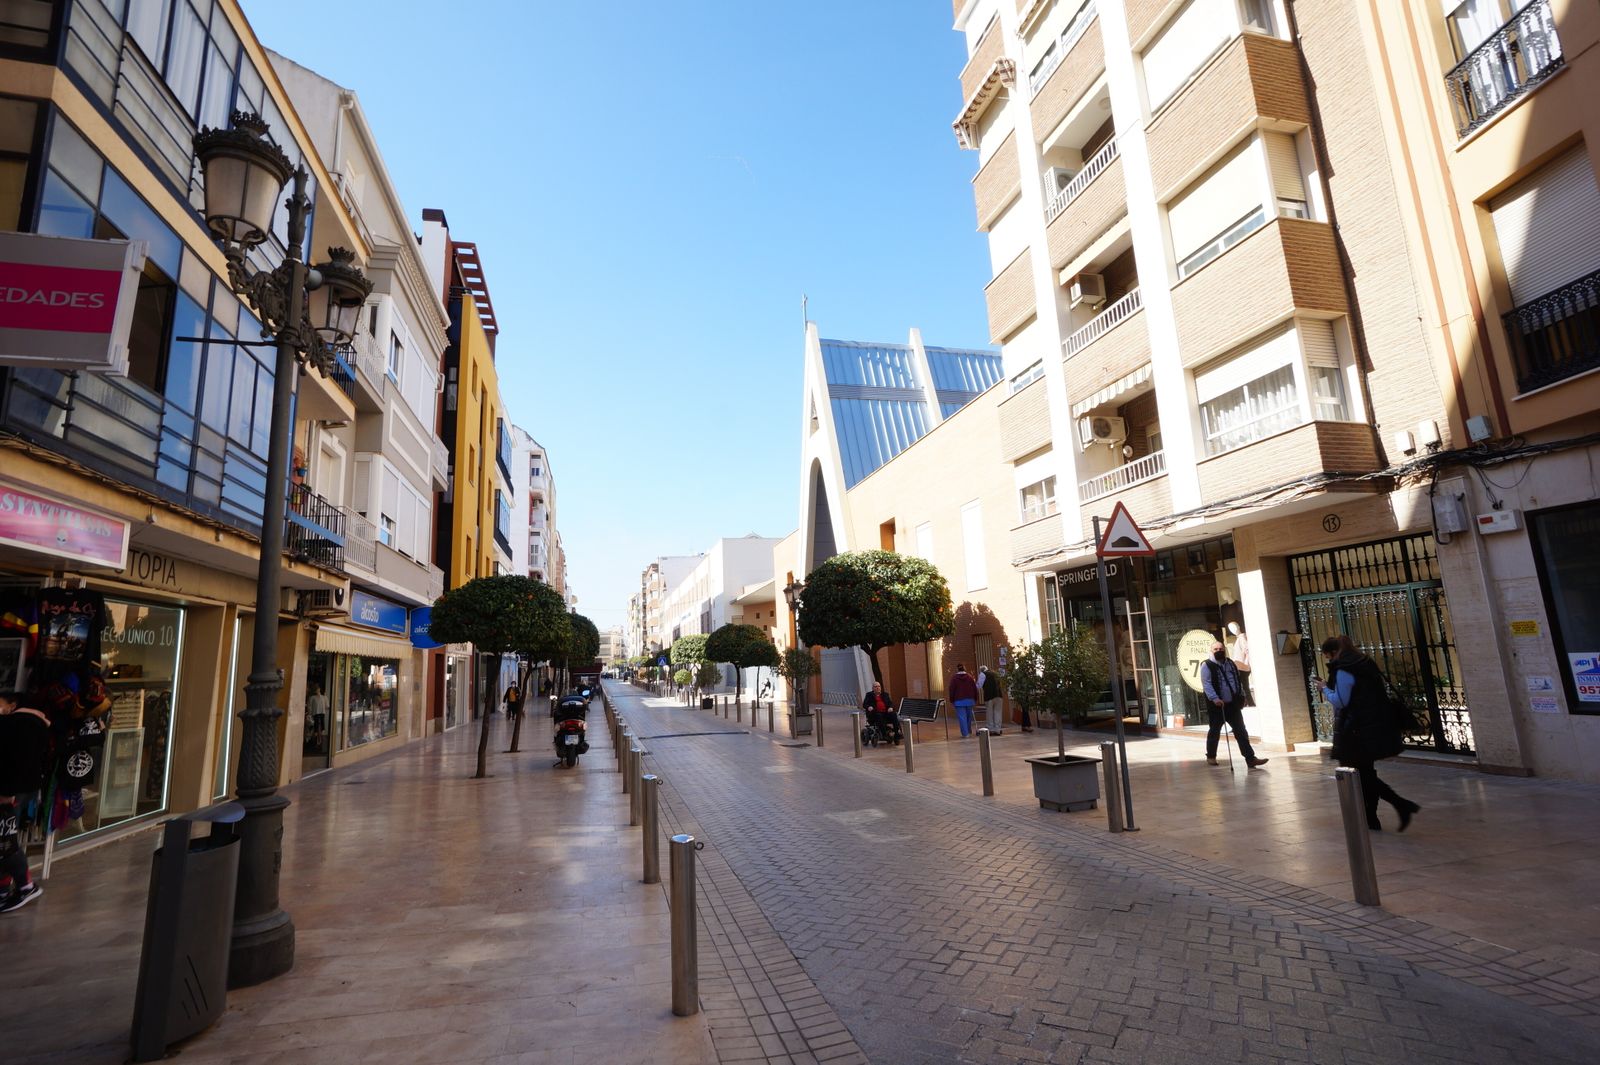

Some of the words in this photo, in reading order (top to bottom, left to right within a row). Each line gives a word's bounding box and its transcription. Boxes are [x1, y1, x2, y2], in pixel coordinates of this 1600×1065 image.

[1325, 517, 1337, 531] 13
[114, 548, 176, 586] TOPIA
[1058, 563, 1117, 587] SPRINGFILD
[127, 625, 156, 646] ÚNICO
[414, 625, 429, 634] alco
[1186, 639, 1211, 647] REMATE
[1183, 659, 1200, 678] -7
